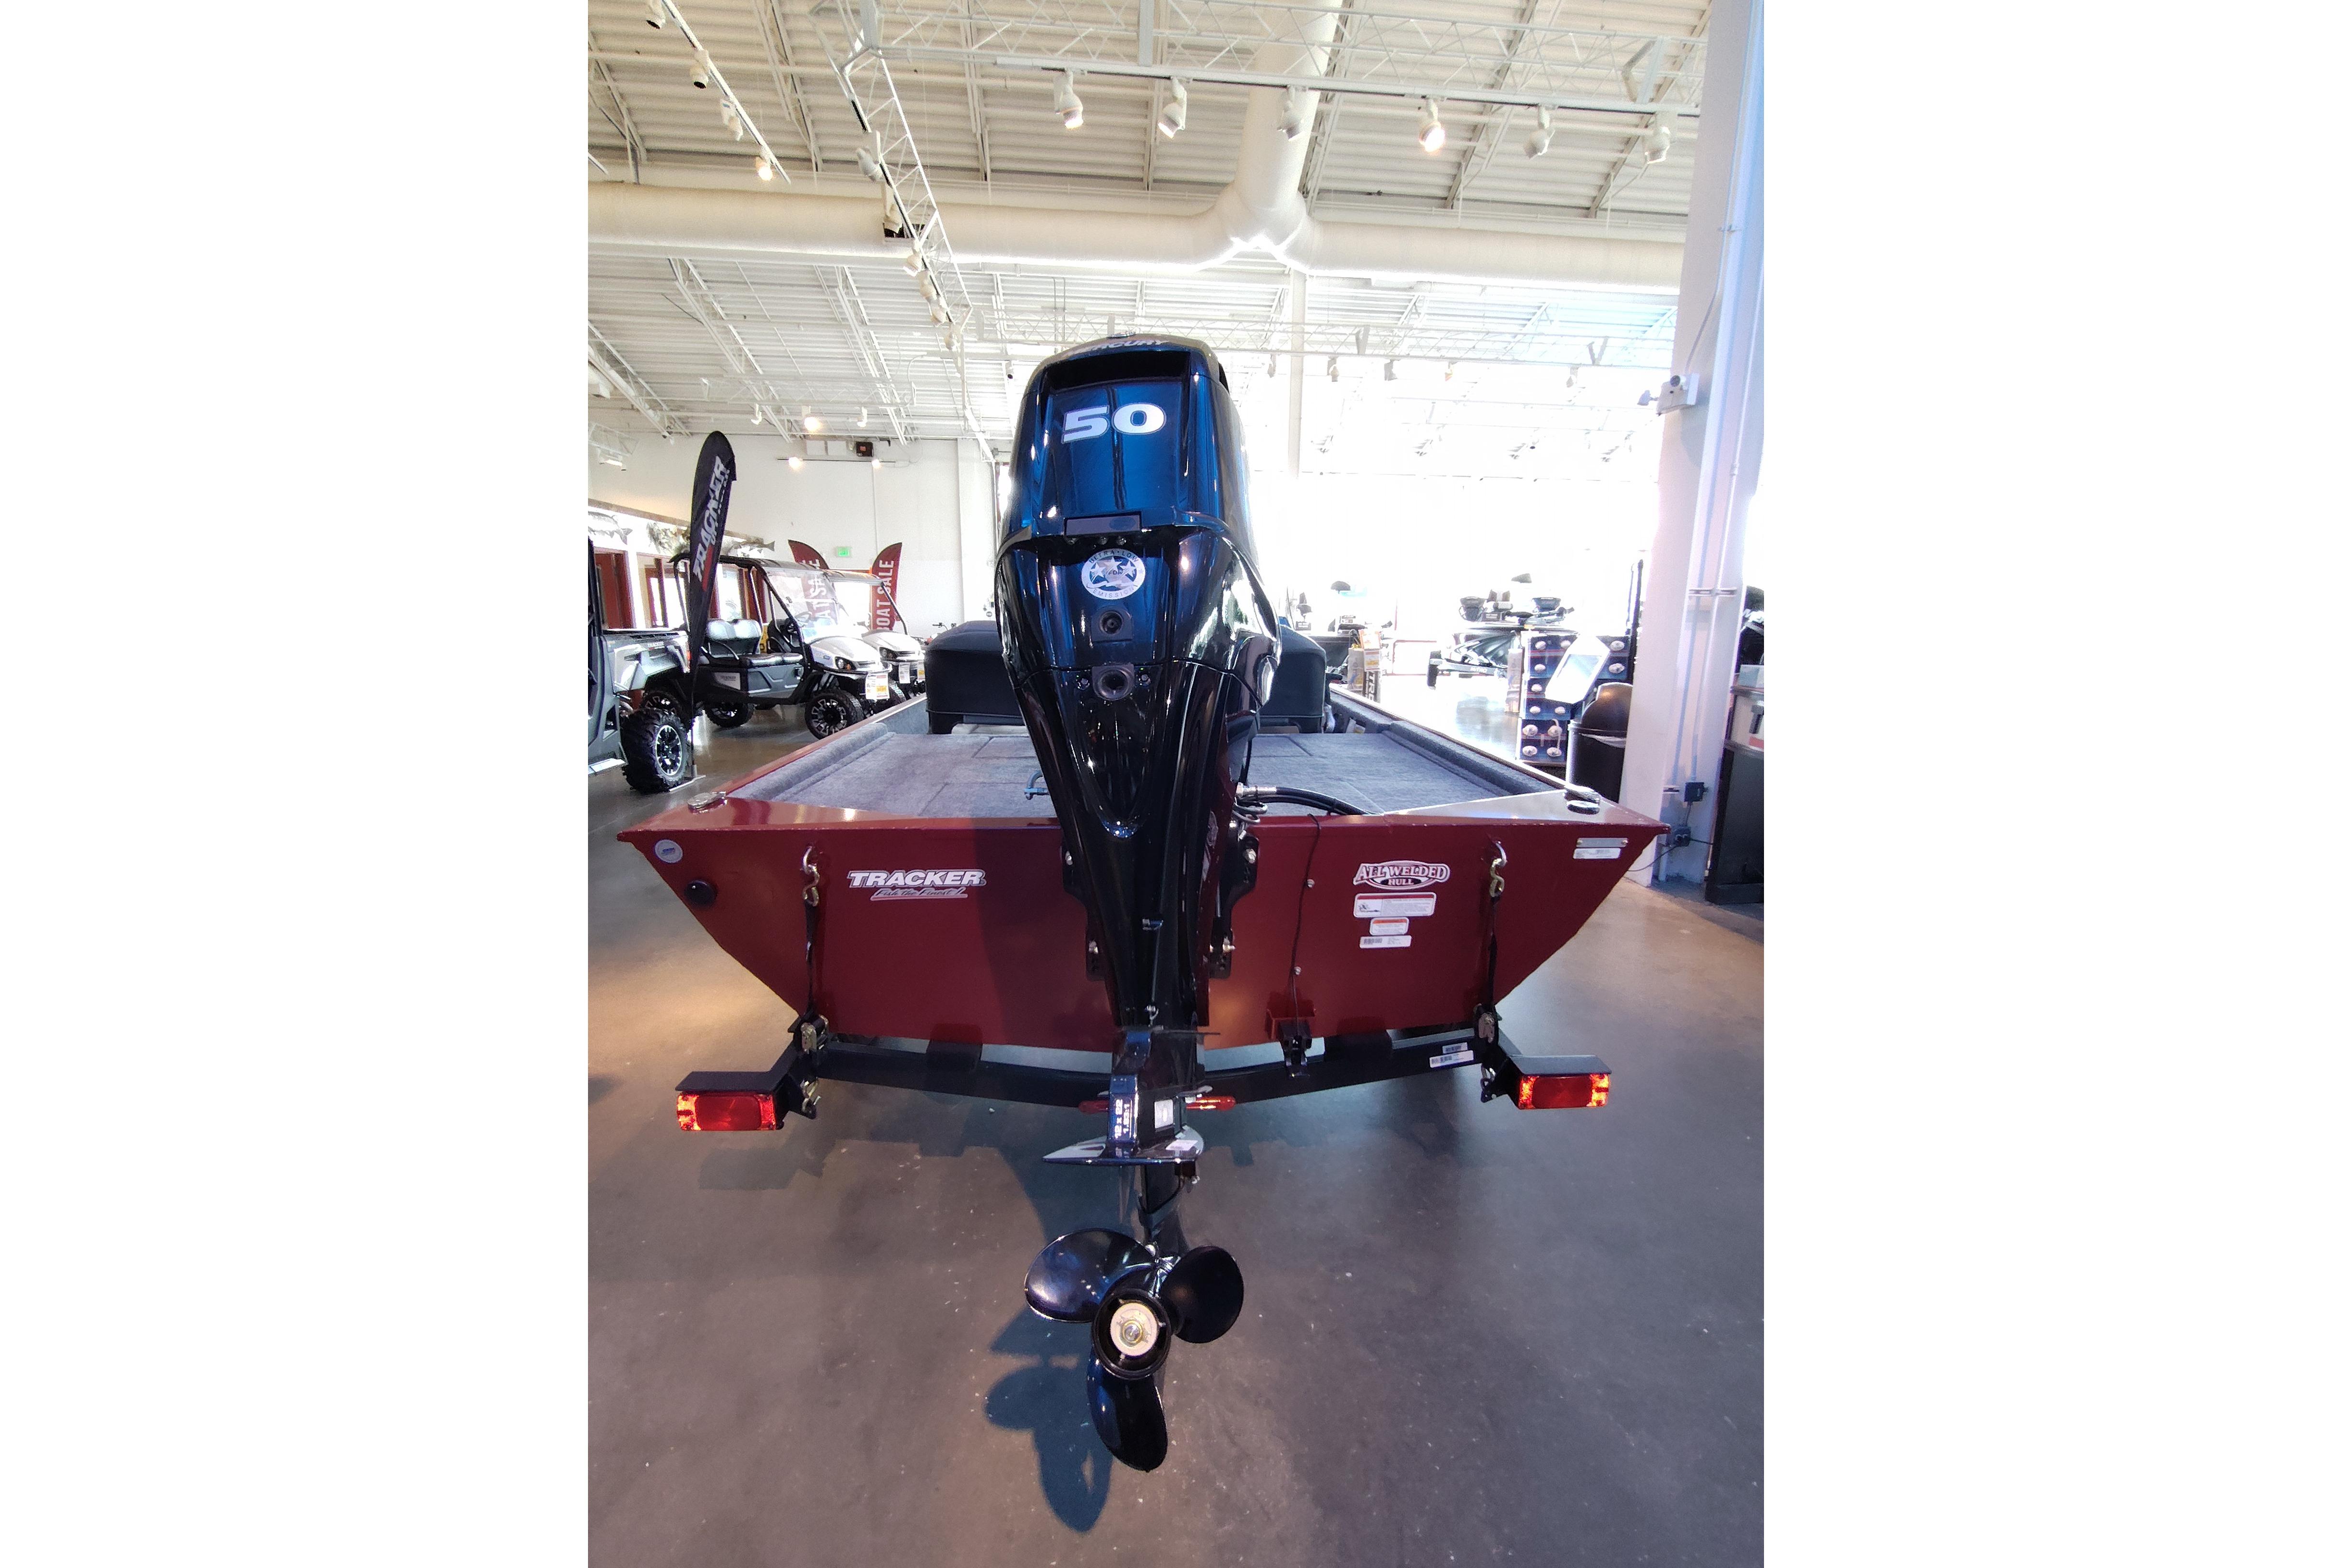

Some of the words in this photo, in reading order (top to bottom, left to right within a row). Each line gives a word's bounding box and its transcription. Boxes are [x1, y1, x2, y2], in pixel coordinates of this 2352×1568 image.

[1061, 403, 1166, 444] 50
[693, 455, 726, 582] TRACKER
[1089, 550, 1115, 564] ULTRA
[1122, 551, 1139, 562] LOW
[877, 560, 894, 595] SALE
[876, 599, 891, 630] OAT
[849, 870, 984, 887] TRACKER
[1356, 865, 1385, 881] ALL
[1386, 866, 1447, 880] WELDED
[1115, 1099, 1123, 1115] 22
[1115, 1125, 1122, 1139] 12
